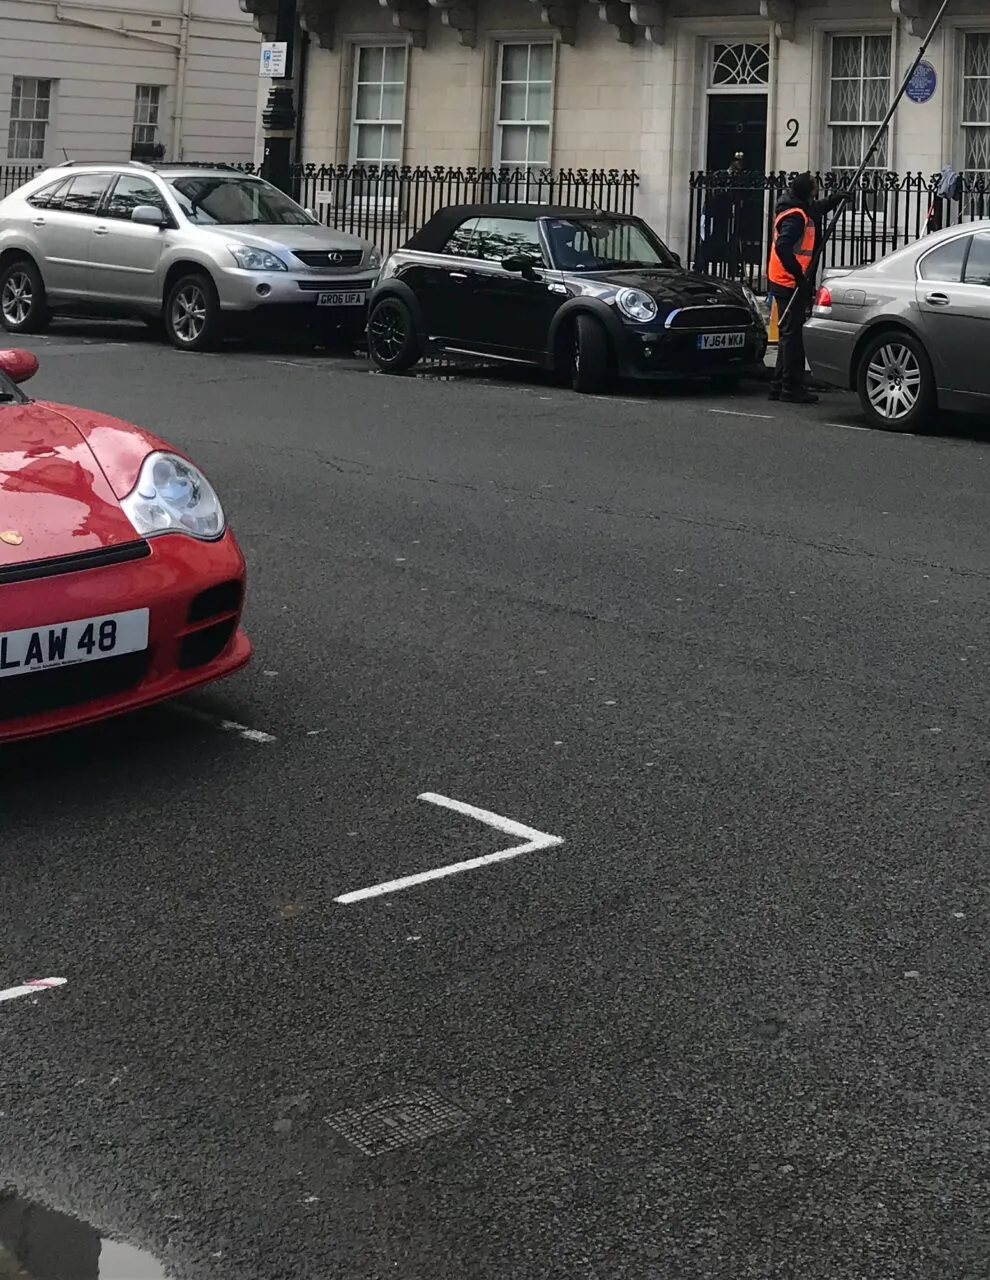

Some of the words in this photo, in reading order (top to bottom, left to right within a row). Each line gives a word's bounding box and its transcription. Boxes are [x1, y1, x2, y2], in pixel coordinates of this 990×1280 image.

[785, 118, 800, 147] 2
[265, 147, 270, 156] 2
[345, 293, 361, 304] UFA
[703, 335, 726, 348] YJ64
[0, 627, 68, 670] LAW
[77, 619, 117, 655] 48
